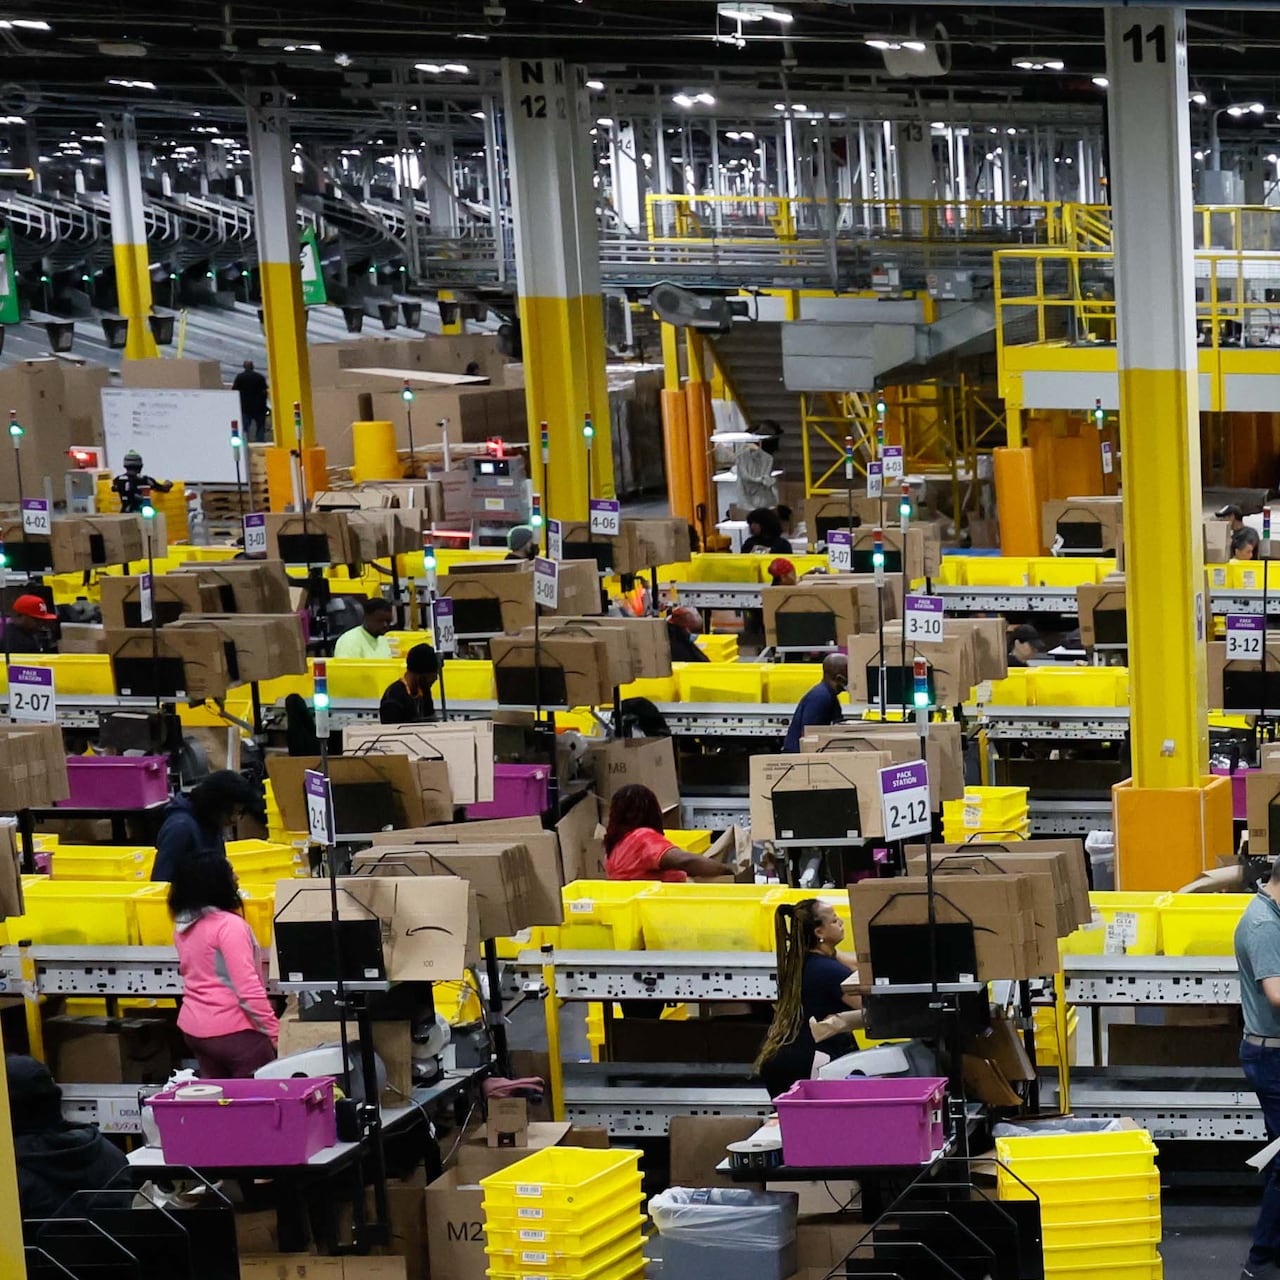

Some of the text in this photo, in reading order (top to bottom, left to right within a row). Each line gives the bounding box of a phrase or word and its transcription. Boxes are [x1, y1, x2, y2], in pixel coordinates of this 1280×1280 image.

[1123, 24, 1166, 63] 11
[520, 61, 545, 84] N
[520, 95, 547, 118] 12
[619, 120, 631, 133] P
[901, 124, 923, 143] 13
[26, 515, 47, 529] 4-02
[592, 517, 617, 530] 4-06
[830, 549, 850, 564] 3-07
[909, 618, 942, 635] 3-10
[1228, 637, 1260, 653] 3-12
[14, 692, 52, 712] 2-07
[892, 775, 918, 789] STATION
[896, 768, 913, 780] PACK
[311, 806, 328, 834] 2-1
[889, 799, 929, 829] 2-12
[447, 1220, 486, 1242] M2
